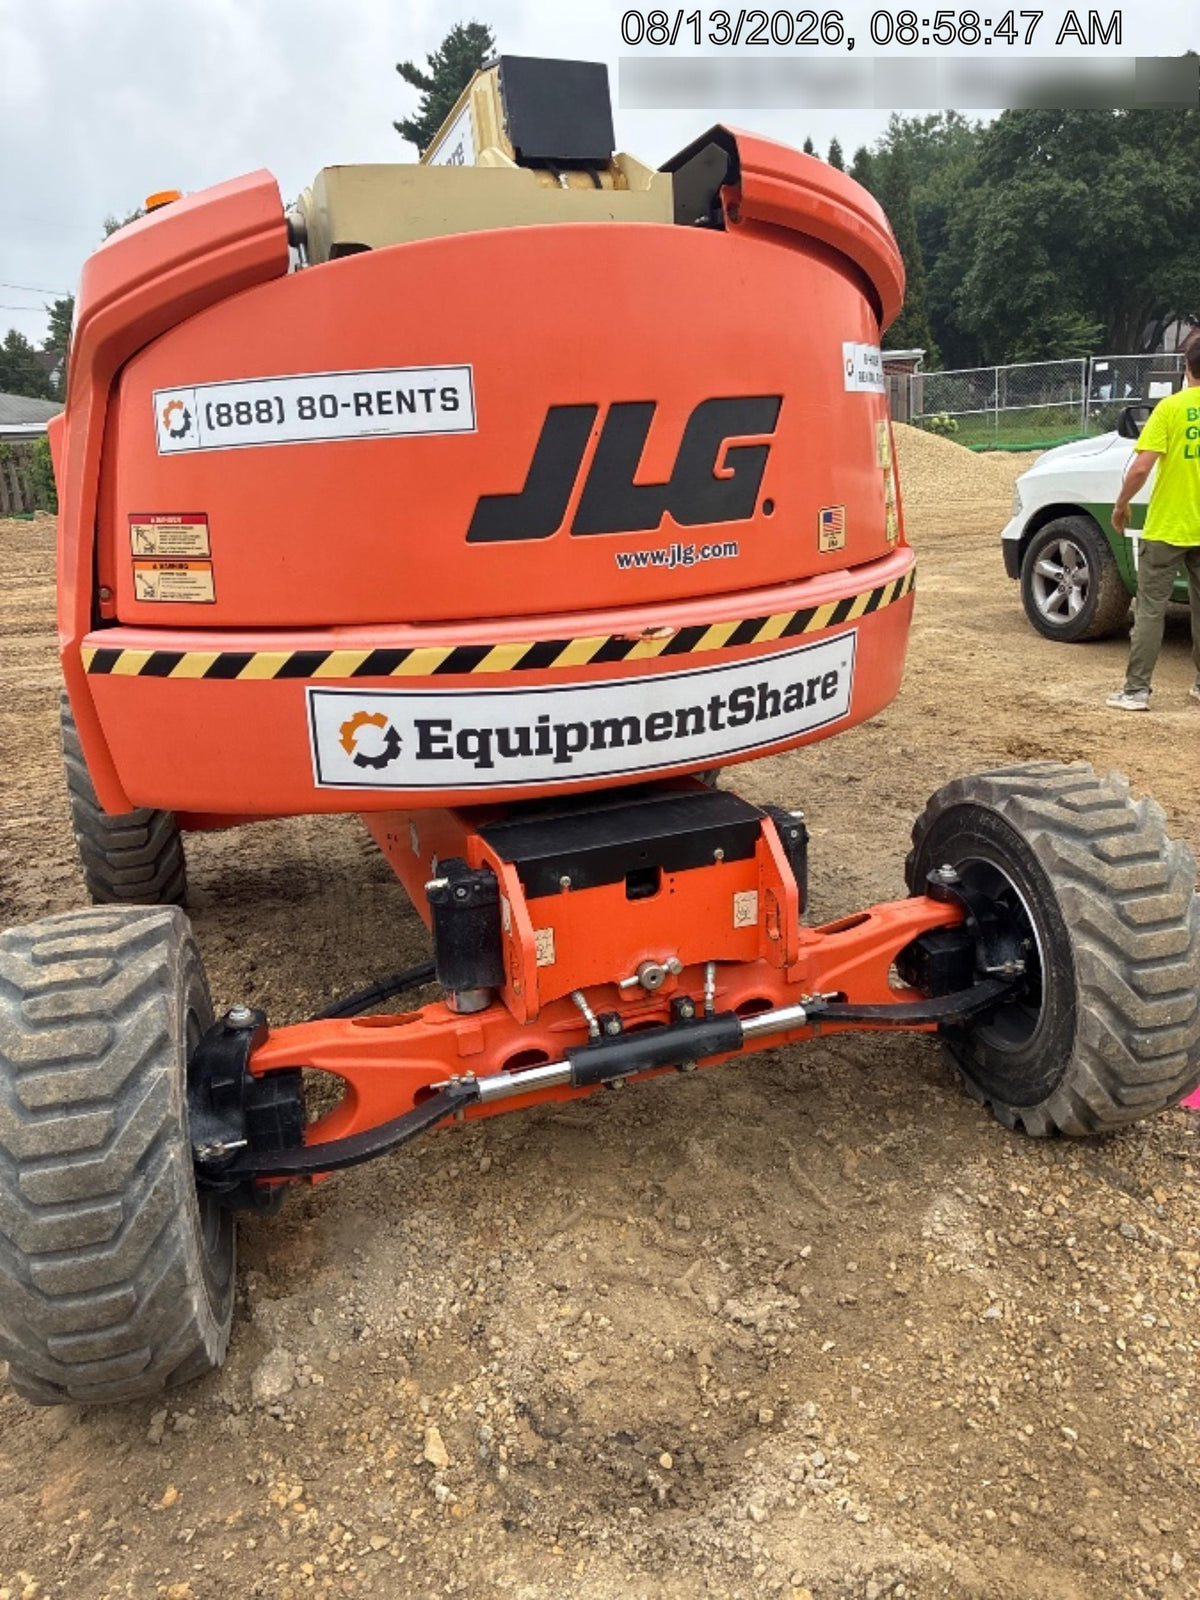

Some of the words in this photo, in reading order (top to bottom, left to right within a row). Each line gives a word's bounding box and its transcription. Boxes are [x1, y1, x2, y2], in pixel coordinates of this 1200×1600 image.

[205, 396, 285, 431] (888)
[297, 387, 460, 421] 80-RENTS
[616, 541, 739, 569] www.jlg.com
[413, 670, 839, 769] EquipmentShare
